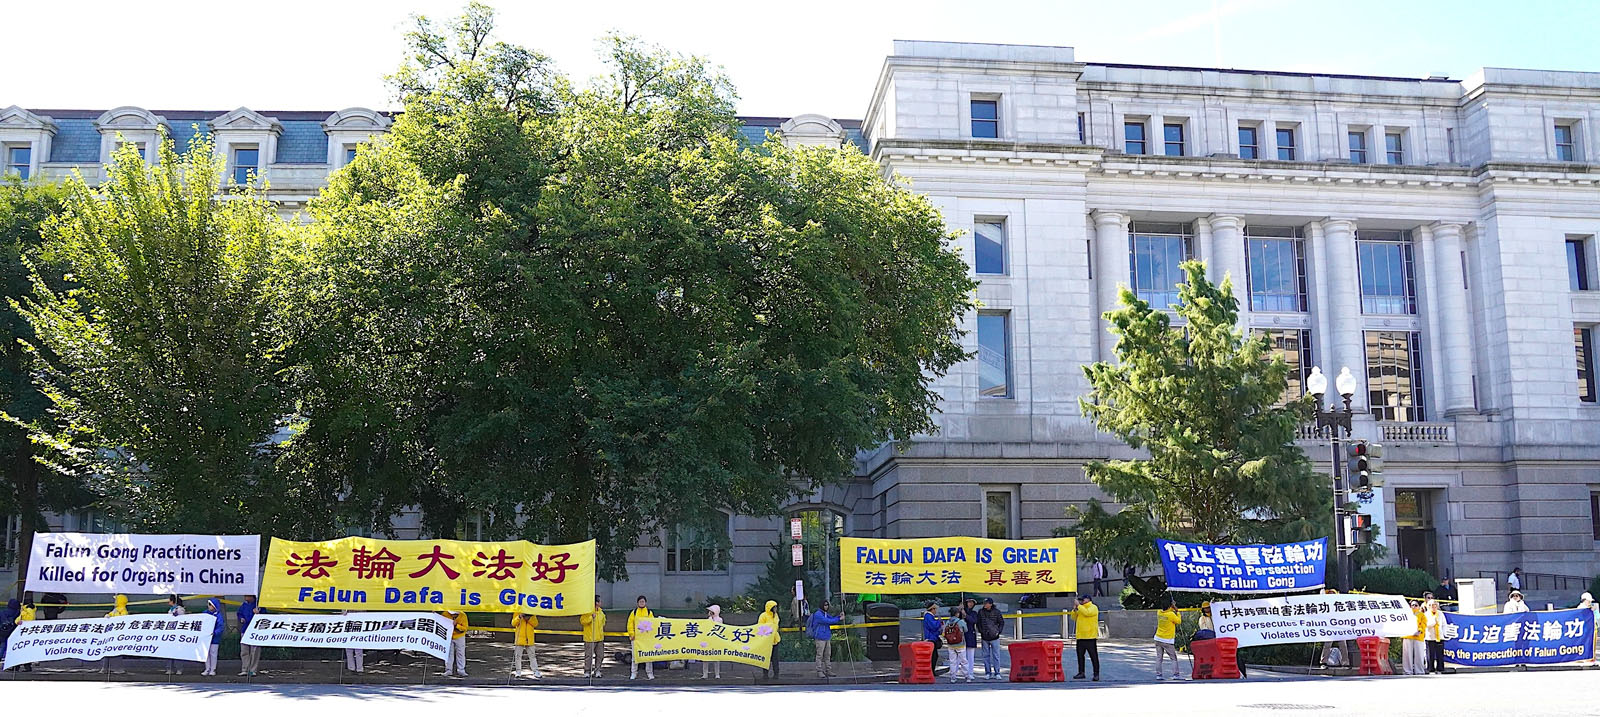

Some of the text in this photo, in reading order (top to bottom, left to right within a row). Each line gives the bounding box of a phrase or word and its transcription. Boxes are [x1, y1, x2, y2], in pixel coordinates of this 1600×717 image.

[46, 543, 242, 562] Falun Gong Practitioners
[856, 546, 1060, 565] FALUN DAFA IS GREAT
[1164, 541, 1324, 565] 停止迫害法輪功
[286, 545, 580, 584] 法輪大法好
[1177, 562, 1315, 576] Stop The Persecution
[39, 566, 245, 586] Killed for Organs in China
[865, 569, 1057, 587] 法輪大法 真善忍
[1198, 576, 1296, 589] of Falun Gong
[298, 586, 564, 611] Falun Dafa is Great
[1333, 599, 1404, 613] 危害美國主權
[128, 619, 203, 632] 危害美國主權
[1219, 613, 1409, 634] CCP Persecutes Falun Gong on US Soil
[12, 640, 31, 652] CCP
[32, 636, 88, 647] Persecutes
[117, 633, 144, 644] Gong
[161, 634, 176, 643] US
[178, 634, 199, 644] Soil
[1261, 626, 1377, 641] Violates US Sovereignty
[44, 646, 84, 657] Violates
[86, 647, 101, 657] US
[250, 632, 447, 654] Stop Killing Falun Gong Practitioners for Organs
[638, 646, 766, 662] Truthfulness Compassion Forbearance
[1444, 644, 1585, 662] top the persecution of Falun Gong
